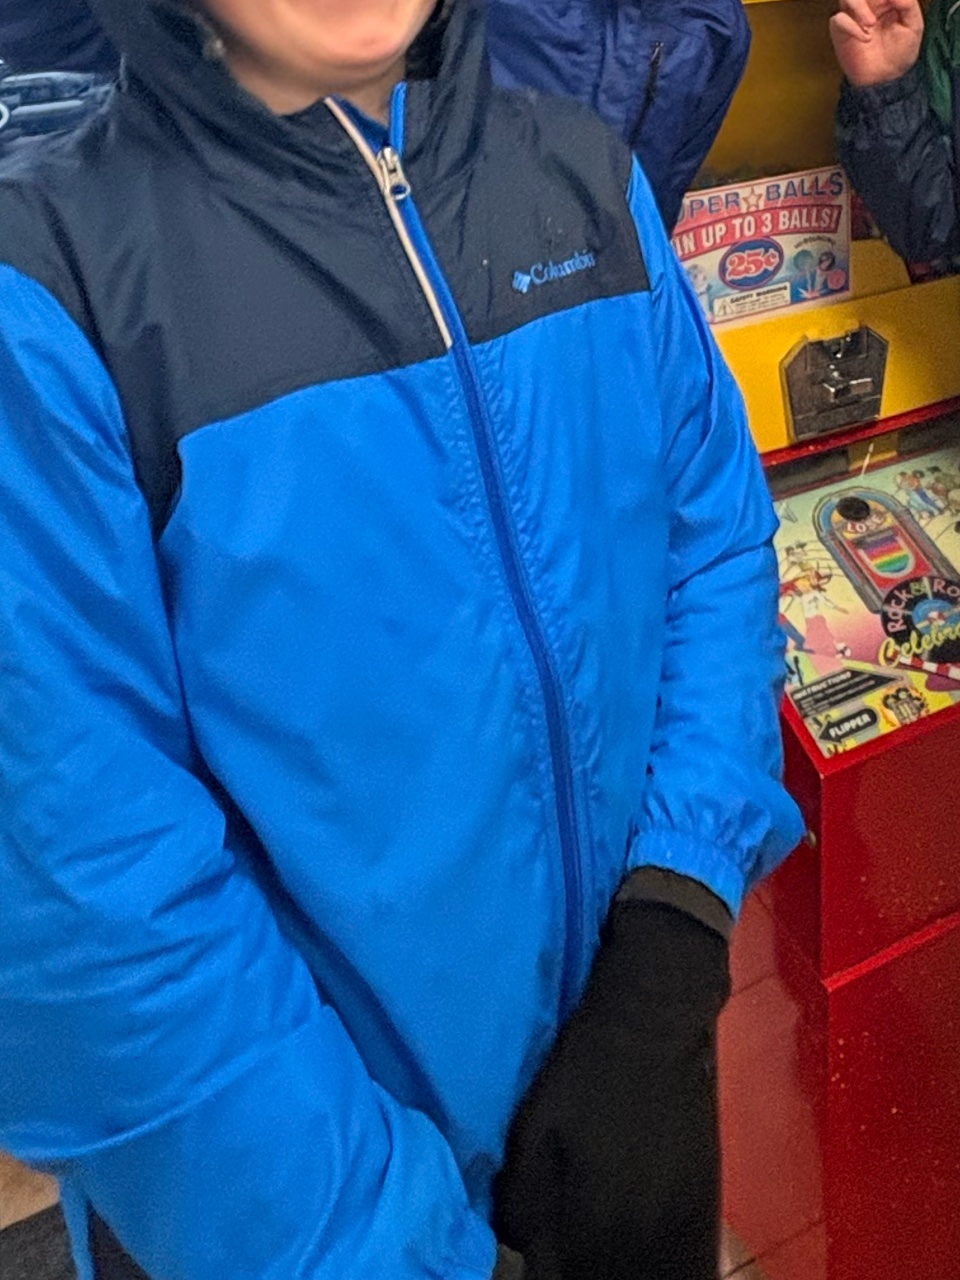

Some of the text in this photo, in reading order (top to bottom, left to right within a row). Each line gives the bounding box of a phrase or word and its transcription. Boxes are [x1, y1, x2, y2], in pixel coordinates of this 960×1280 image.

[679, 171, 844, 223] PER BALLS
[673, 207, 839, 258] IN UP TO 3 BALLS!
[828, 713, 872, 738] FLIPPER
